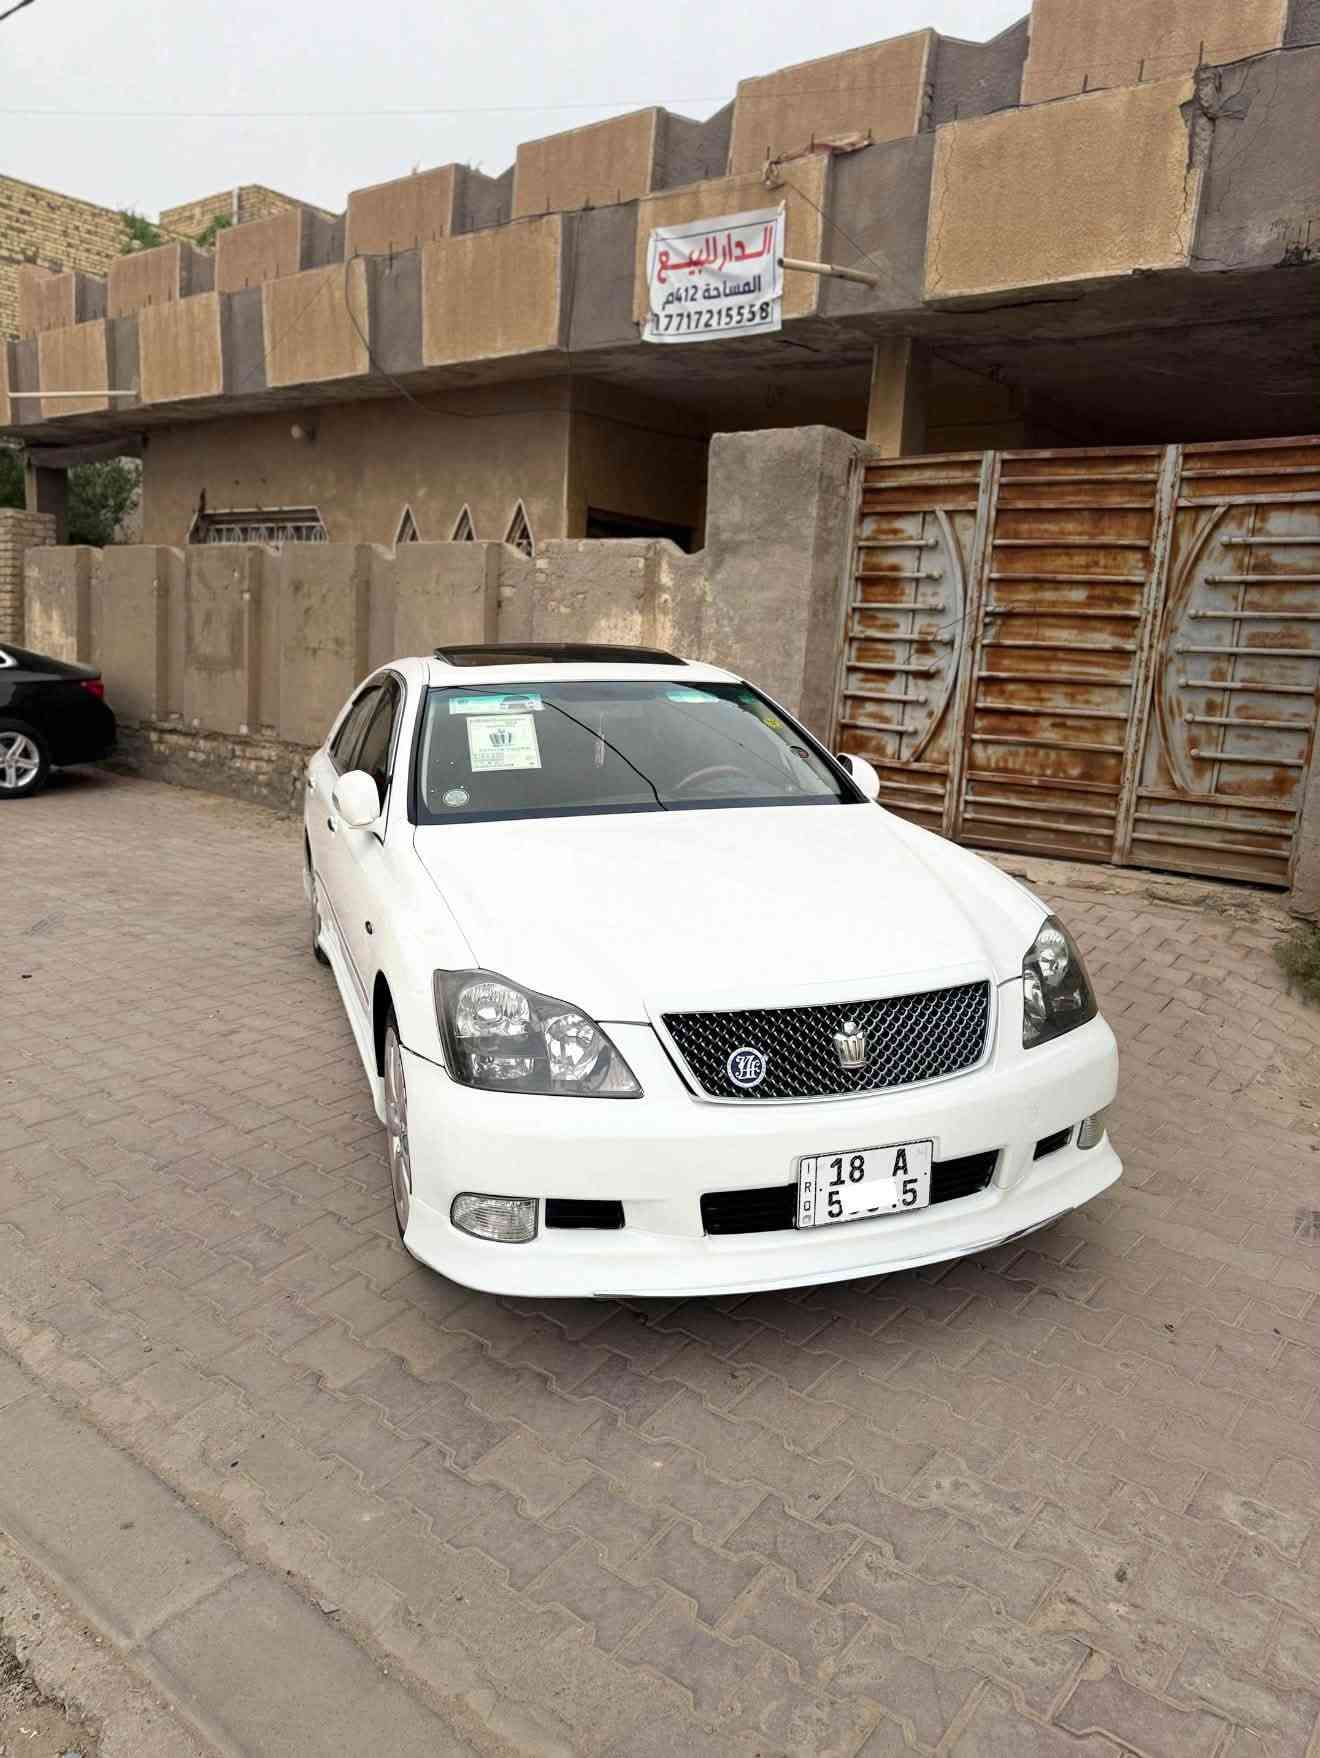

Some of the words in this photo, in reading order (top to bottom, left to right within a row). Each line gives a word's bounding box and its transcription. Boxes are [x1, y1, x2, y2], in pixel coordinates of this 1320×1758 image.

[657, 236, 718, 284] للبيع
[718, 224, 773, 272] الدار
[703, 275, 761, 299] المساحة
[829, 1155, 865, 1186] 18
[892, 1148, 908, 1176] A
